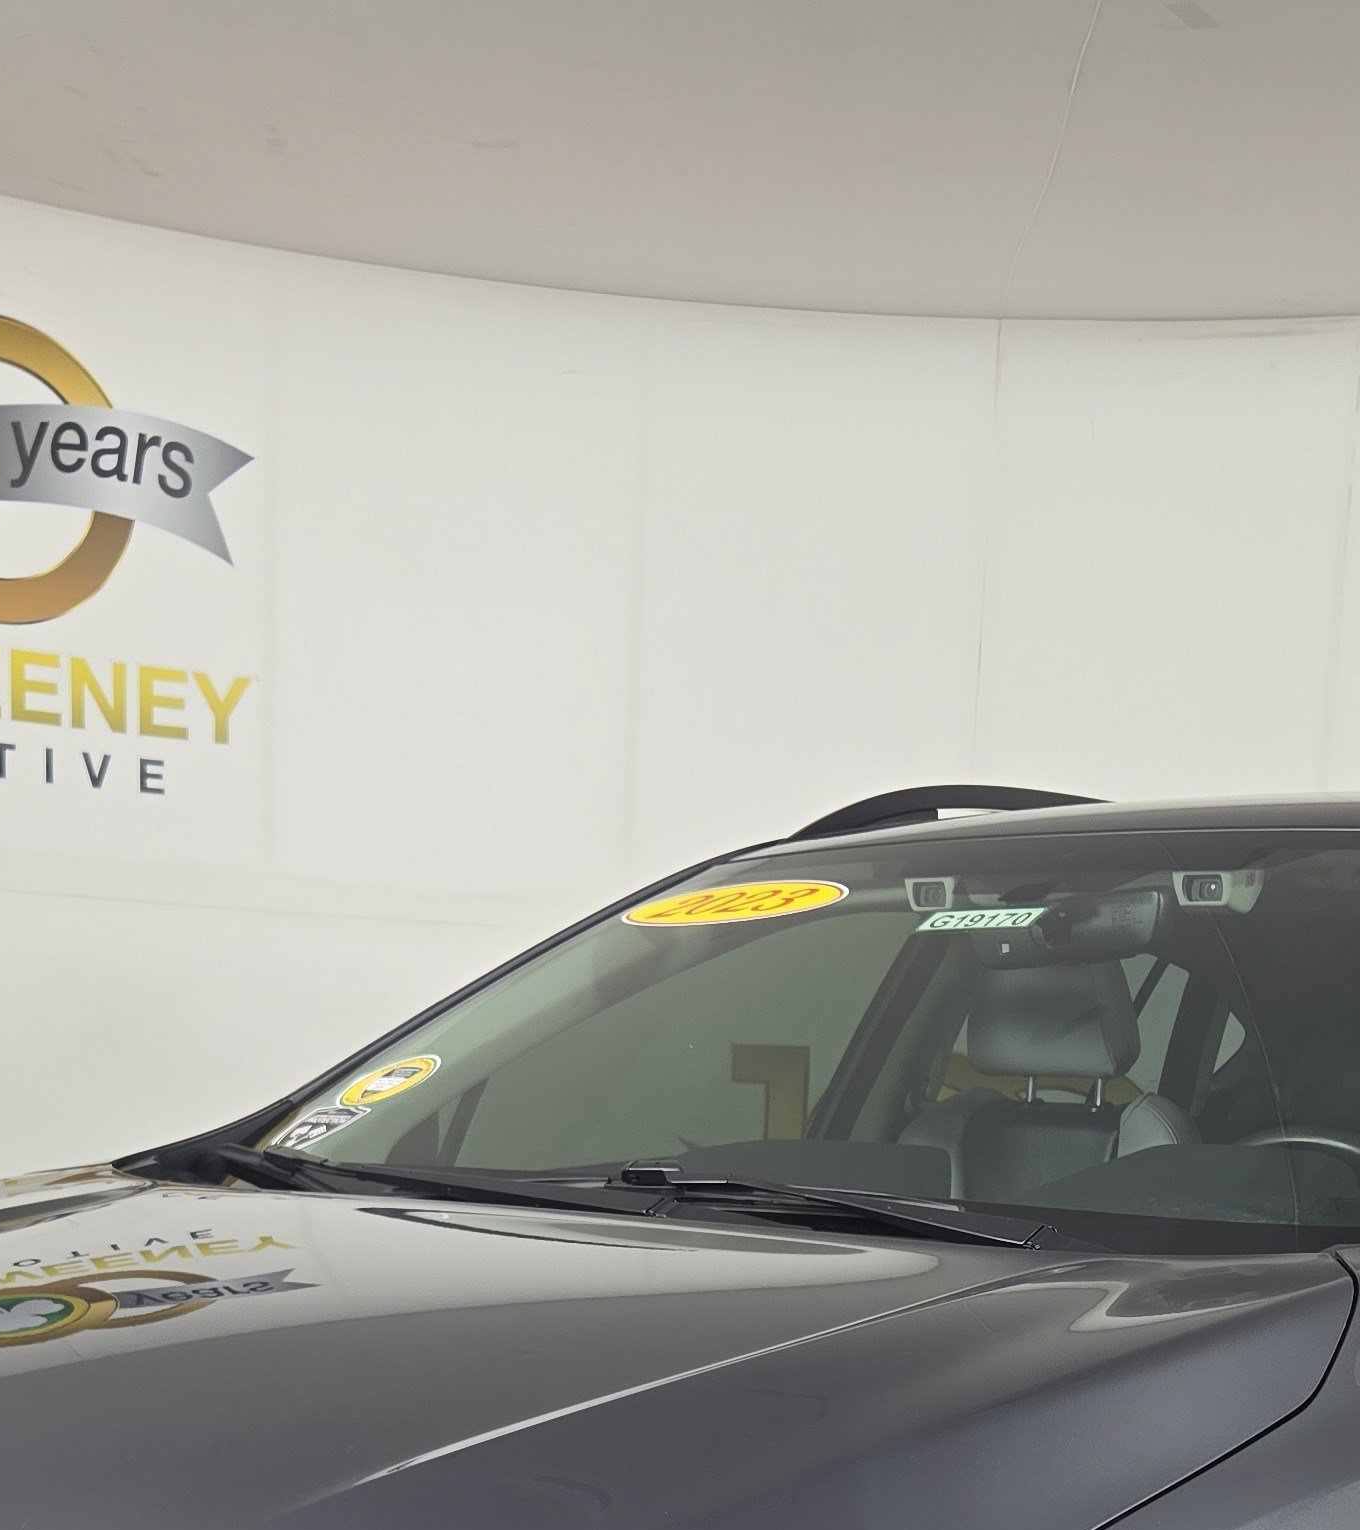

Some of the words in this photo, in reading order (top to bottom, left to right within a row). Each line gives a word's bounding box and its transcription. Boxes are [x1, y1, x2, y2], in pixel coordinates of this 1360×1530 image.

[9, 418, 197, 500] years
[643, 887, 821, 920] 2023
[929, 911, 1034, 929] G19170
